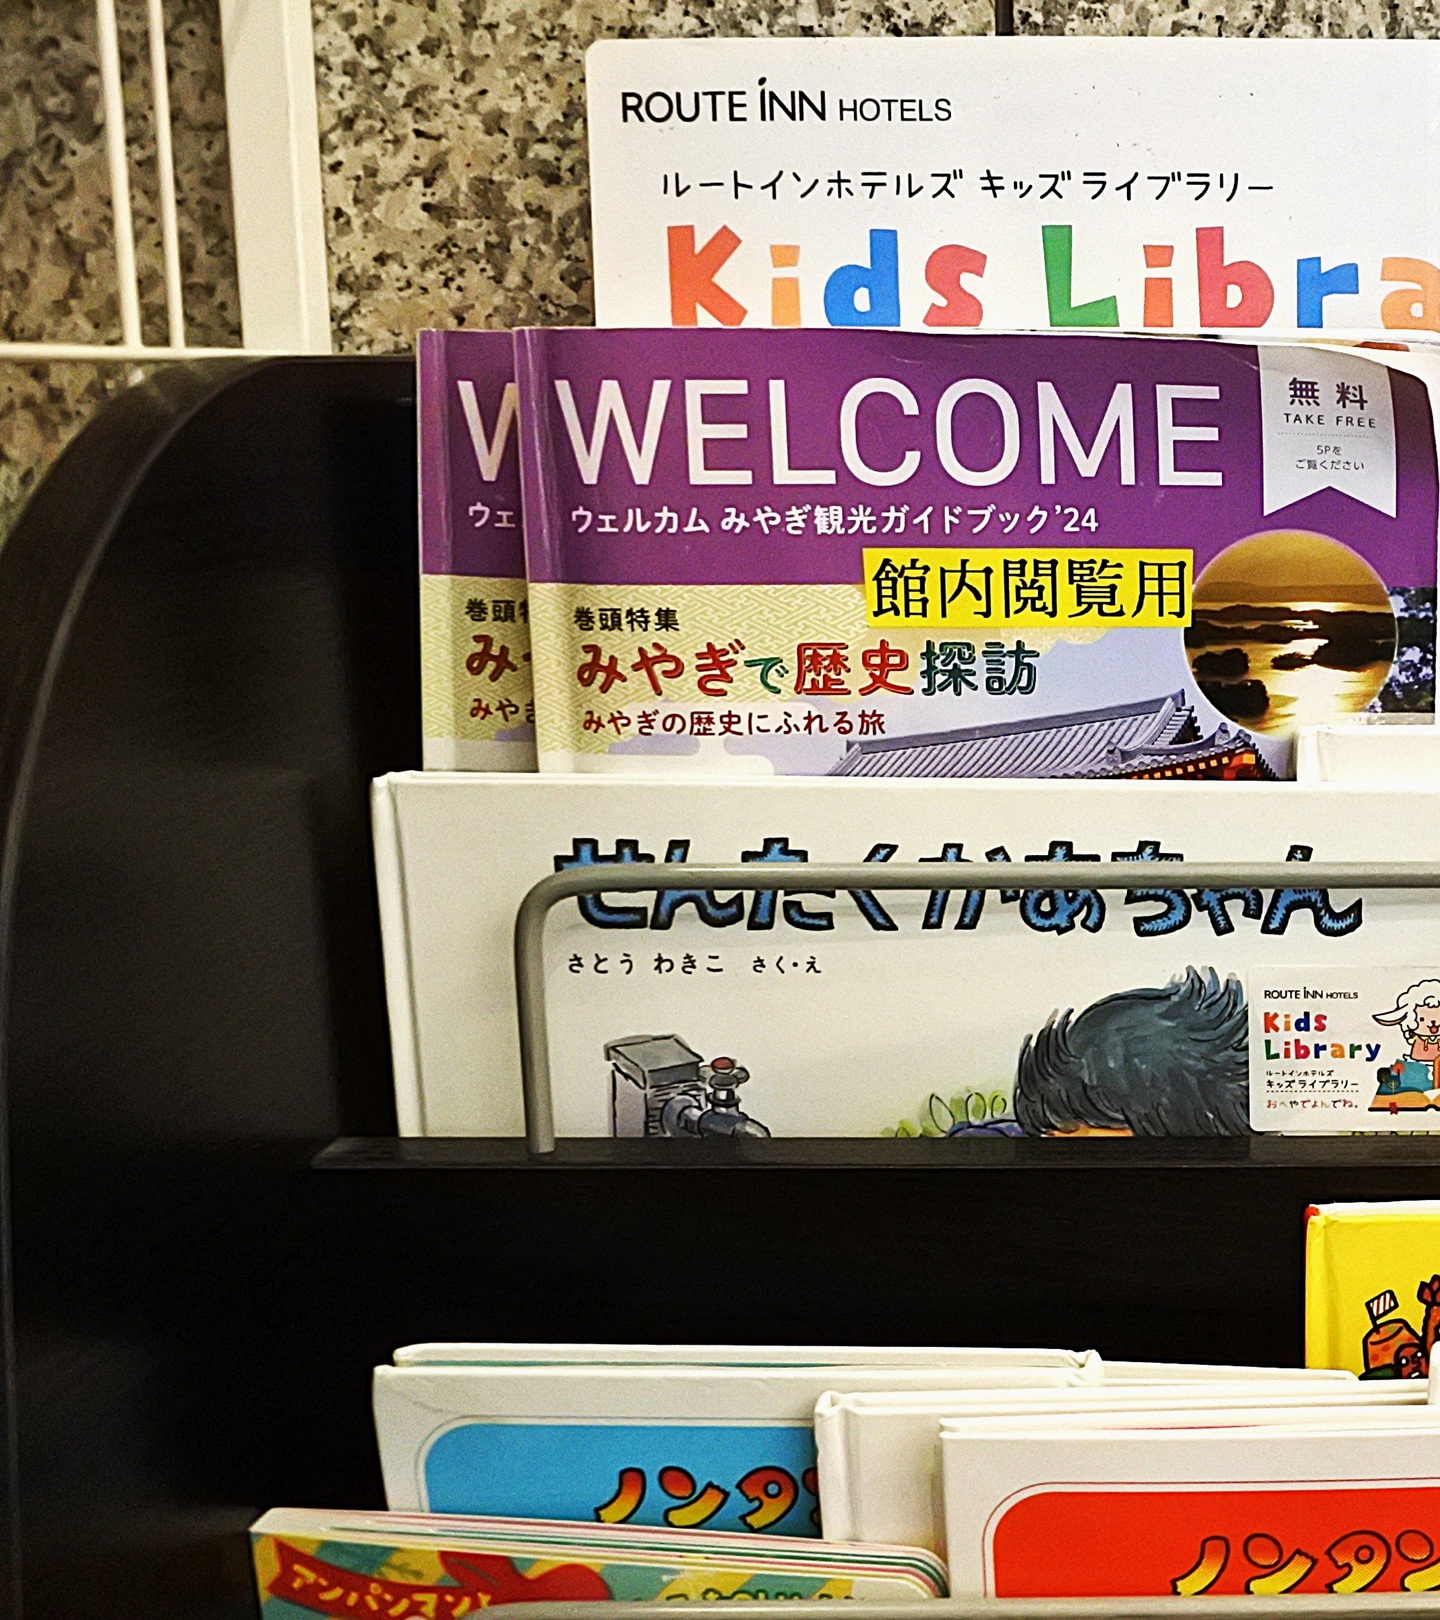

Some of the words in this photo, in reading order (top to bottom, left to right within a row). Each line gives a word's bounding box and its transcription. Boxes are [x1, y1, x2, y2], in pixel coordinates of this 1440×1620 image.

[622, 90, 749, 122] ROUTE
[839, 97, 952, 123] HOTELS
[661, 168, 965, 200] ルートインホテルズ
[979, 167, 1072, 202] キッズ
[1081, 168, 1275, 203] ライブラリー
[666, 224, 988, 328] Kids
[1289, 377, 1368, 411] 無料
[555, 377, 1223, 487] WELCOME
[1284, 413, 1325, 425] TAKE
[1336, 416, 1376, 428] FREE
[1316, 445, 1342, 456] 5Pを
[1296, 459, 1365, 471] ご覧ください
[571, 507, 710, 534] ウェルカム
[871, 556, 1189, 619] 館内閲覧用
[573, 607, 680, 633] 巻頭特集
[576, 637, 1040, 698] みやぎで歴史探訪
[582, 709, 886, 738] みやぎの歴史にふれる旅
[568, 953, 634, 975] さとう
[653, 953, 724, 975] わきこ
[1264, 990, 1300, 1000] ROUTE
[1326, 992, 1359, 1000] HOTELS
[1263, 1011, 1327, 1034] Kids
[1264, 1039, 1381, 1062] Library
[1266, 1079, 1296, 1090] キッズ
[1298, 1079, 1360, 1090] ライブラリー
